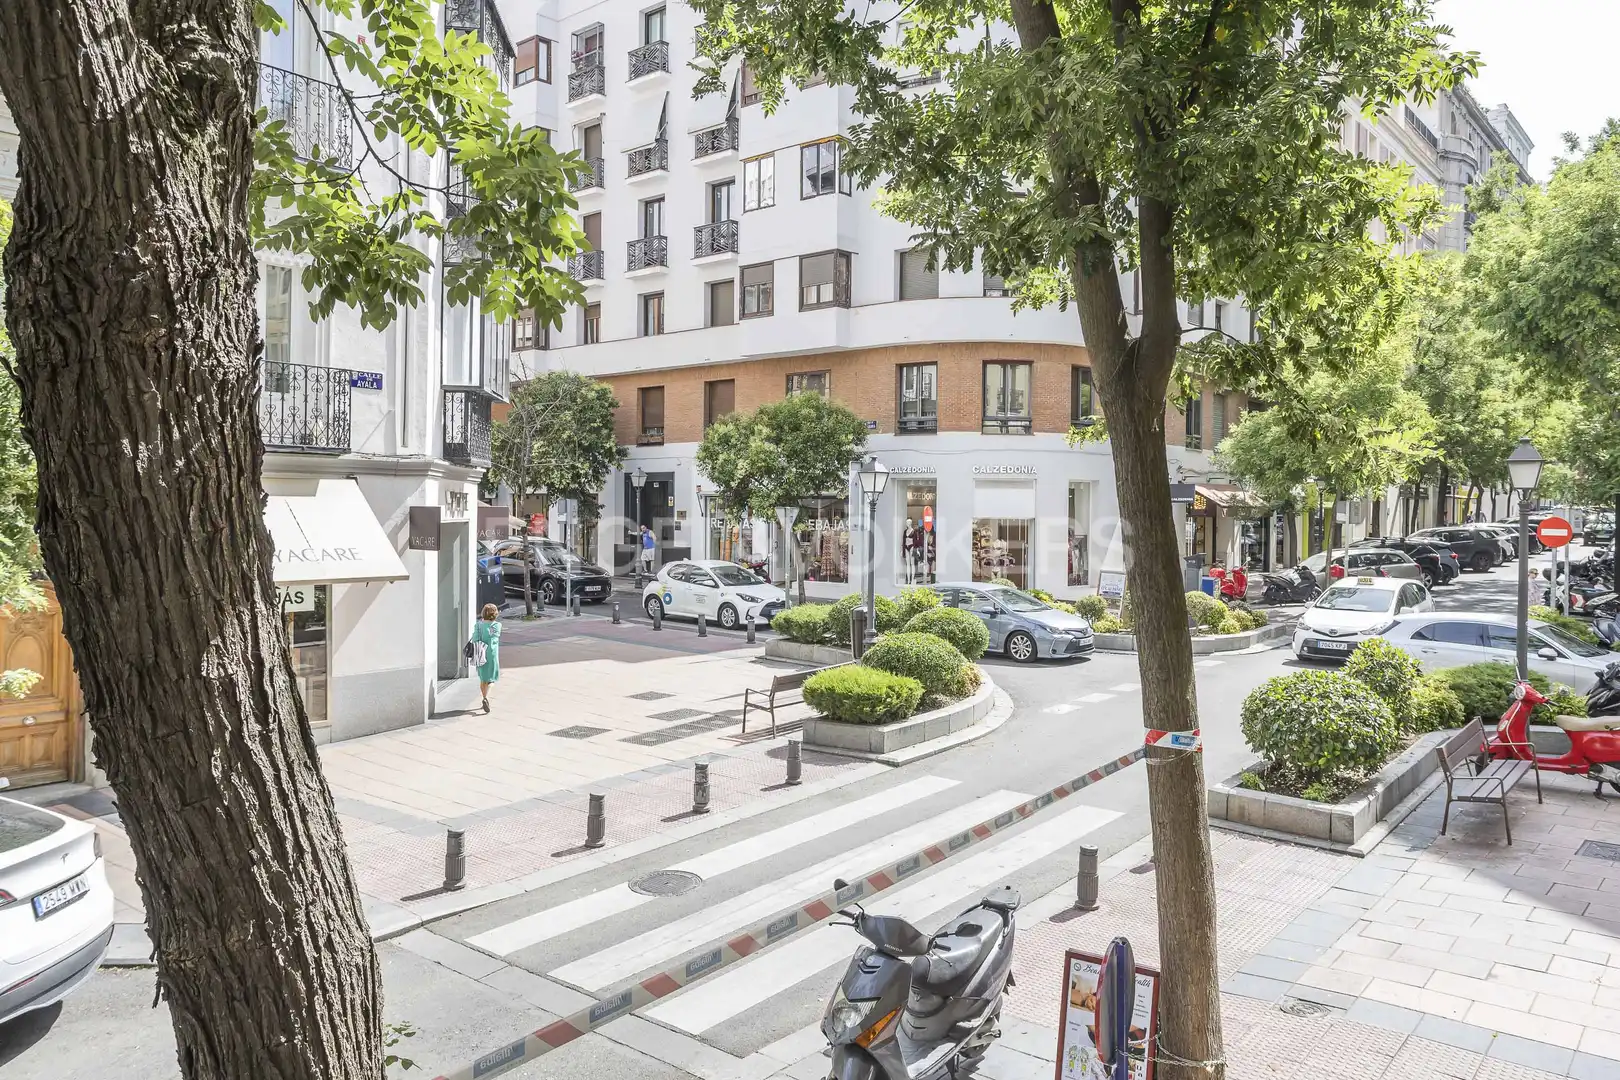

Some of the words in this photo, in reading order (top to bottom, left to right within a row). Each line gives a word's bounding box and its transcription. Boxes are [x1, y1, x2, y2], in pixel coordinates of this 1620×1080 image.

[358, 372, 382, 380] CALLE
[356, 380, 378, 389] AYALA
[889, 466, 936, 474] CALZEDONIA
[972, 465, 1038, 475] CALZEDONIA
[411, 536, 436, 547] YACARE
[43, 887, 68, 910] 2549
[884, 943, 903, 953] HONDA
